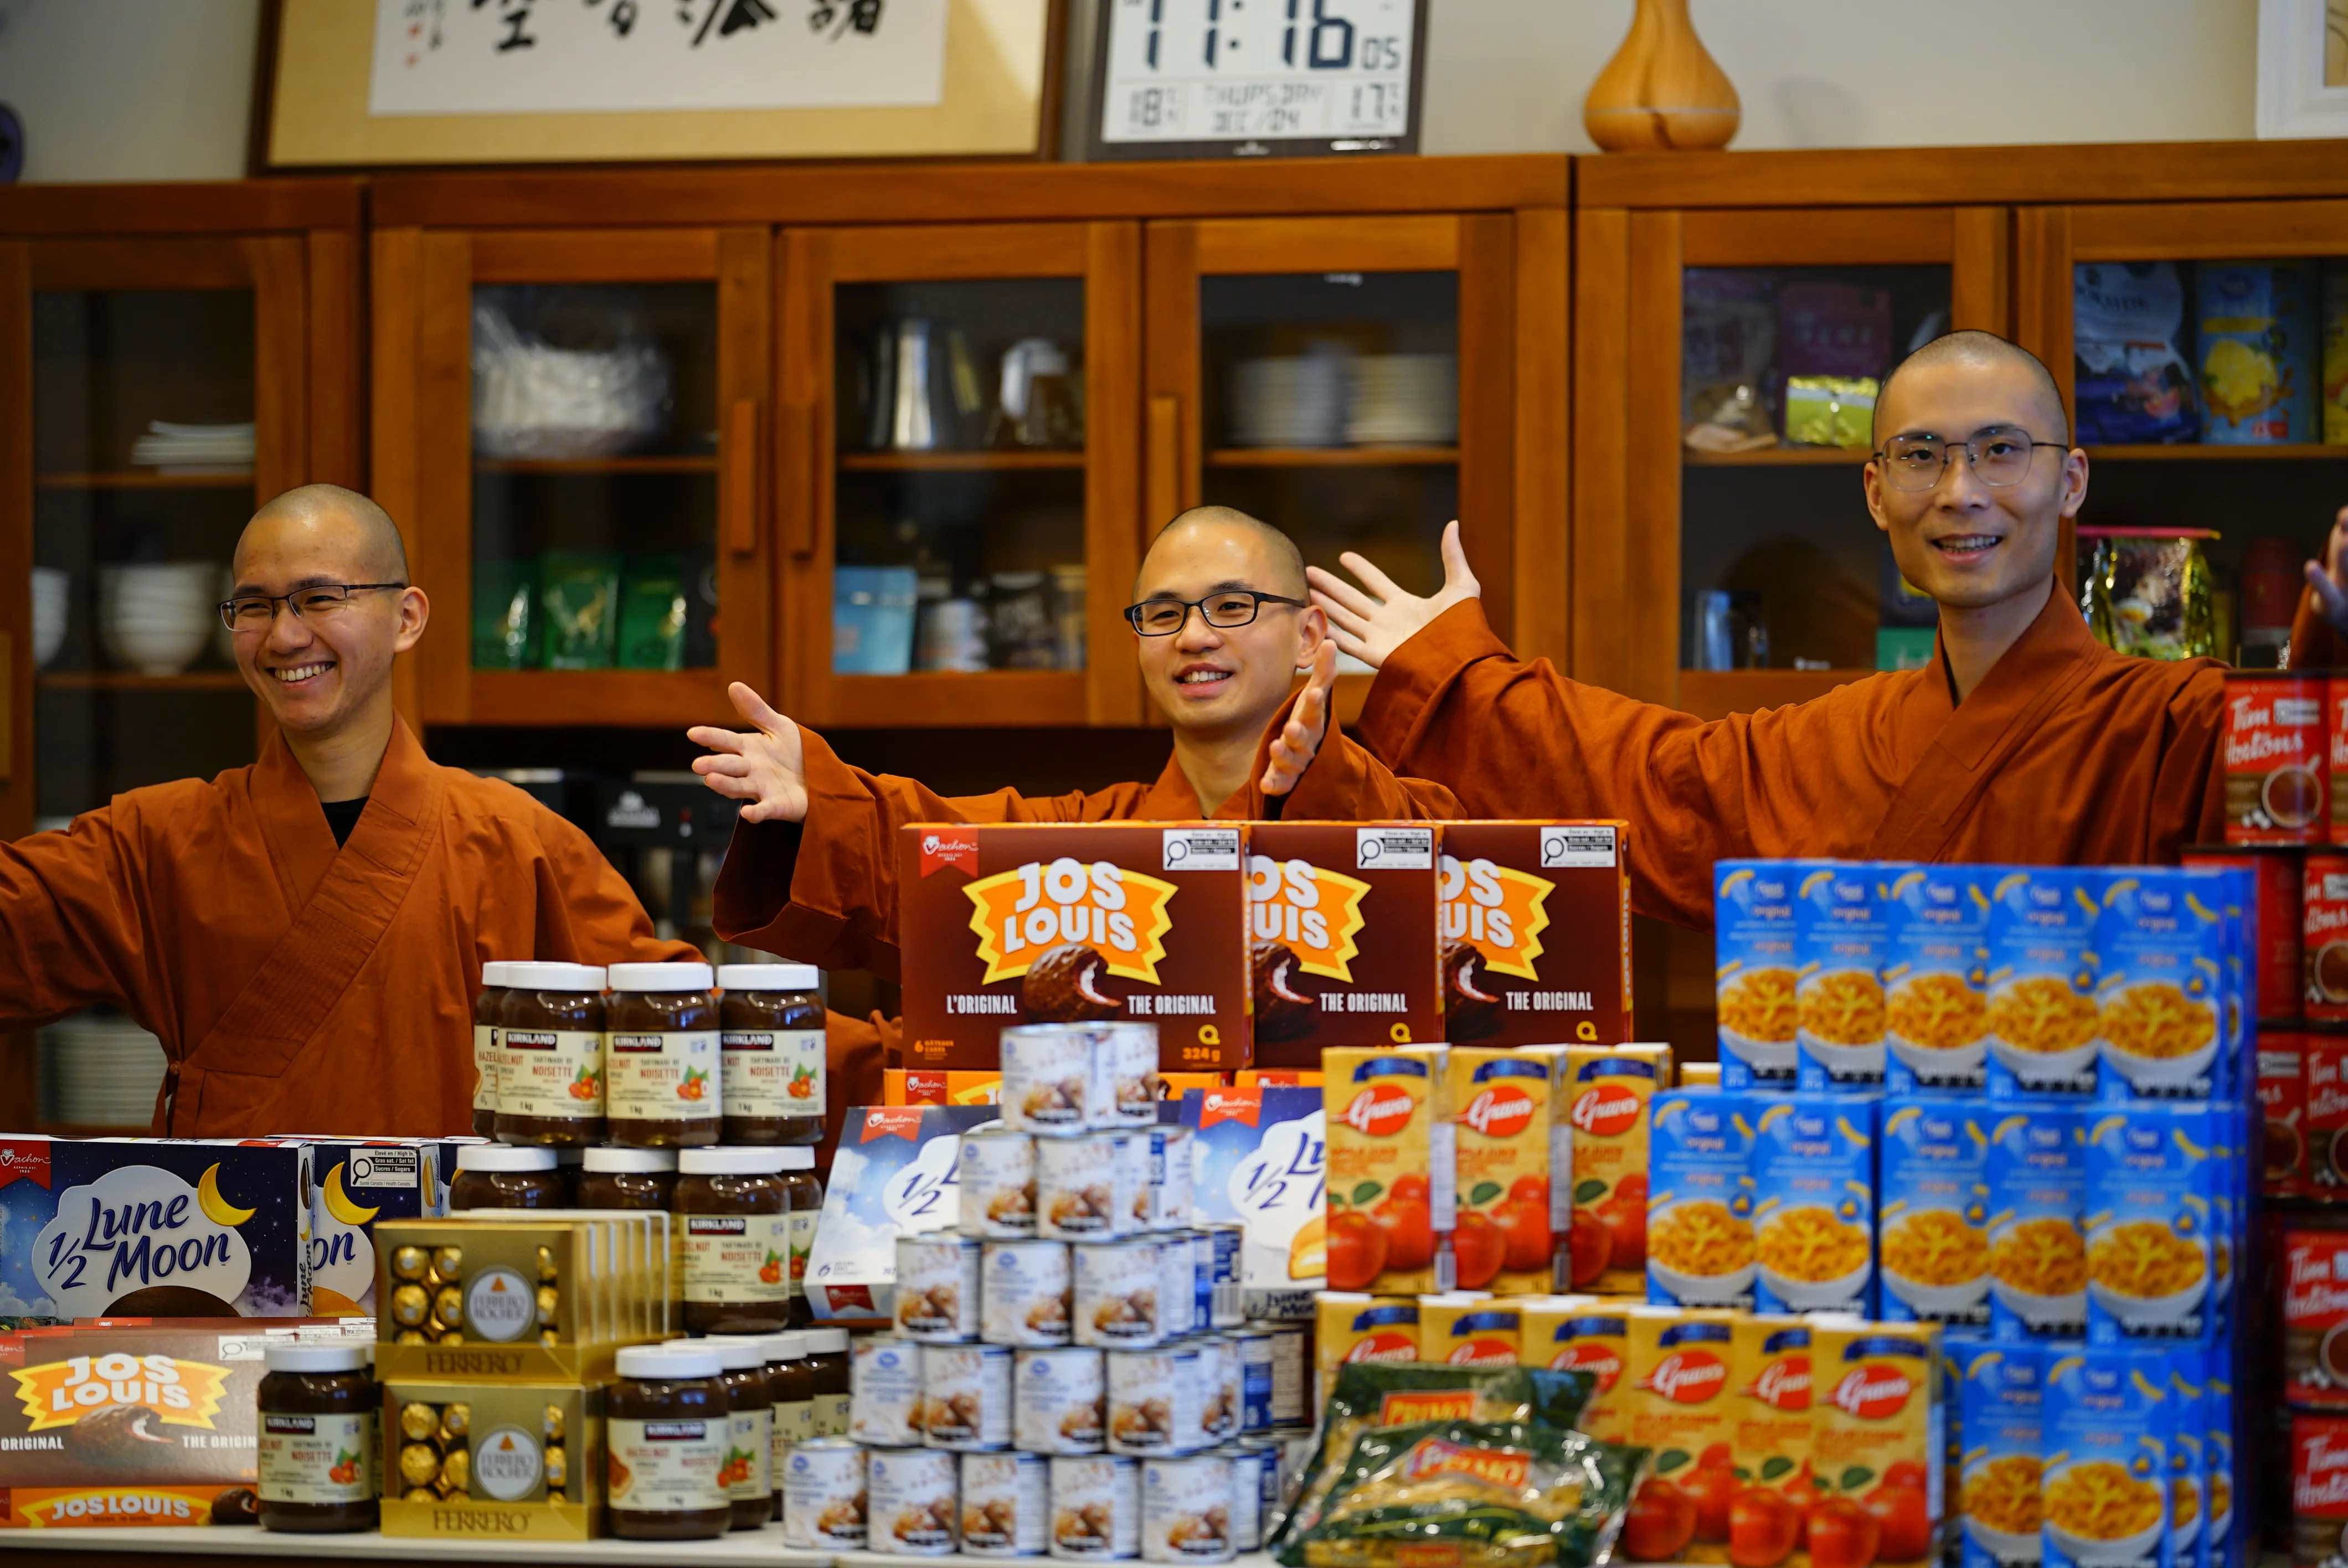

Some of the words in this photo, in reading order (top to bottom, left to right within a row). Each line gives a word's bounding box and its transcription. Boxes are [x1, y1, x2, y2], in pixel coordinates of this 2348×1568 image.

[1144, 0, 1355, 70] 11:16
[1360, 36, 1401, 70] 05
[1351, 83, 1384, 120] 17
[2230, 695, 2269, 732] Tim
[2225, 730, 2304, 766] Hortons
[1015, 857, 1126, 913] JOS
[1250, 855, 1320, 909] OS
[1441, 855, 1504, 907] OS
[1004, 904, 1137, 954] LOUIS
[1253, 903, 1330, 950] UIS
[1441, 903, 1515, 948] UIS
[946, 994, 1017, 1014] L'ORIGINAL
[1127, 995, 1153, 1014] THE
[1155, 995, 1216, 1014] ORIGINAL
[1320, 993, 1344, 1013] THE
[1347, 993, 1408, 1013] ORIGINAL
[1506, 991, 1530, 1010] THE
[1533, 991, 1594, 1010] ORIGINAL
[507, 1033, 556, 1045] KIRKLAND
[615, 1036, 662, 1047] KIRKLAND
[723, 1035, 773, 1045] KIRKLAND
[914, 1040, 924, 1053] 6
[1182, 1047, 1209, 1060] 324
[533, 1066, 573, 1077] NOISETTE
[640, 1069, 679, 1079] NOISETTE
[750, 1066, 790, 1077] NOISETTE
[1, 1153, 51, 1166] Vachon
[83, 1194, 190, 1251] Lune
[691, 1219, 745, 1230] KIRKLAND
[108, 1233, 231, 1293] Moon
[313, 1231, 356, 1270] on
[721, 1251, 762, 1262] NOISETTE
[299, 1263, 309, 1307] Lune
[64, 1354, 180, 1387] JOS
[426, 1352, 522, 1375] FERRERO
[52, 1381, 191, 1411] LOUIS
[1388, 1400, 1470, 1425] PRIMO
[1, 1437, 65, 1452] ORIGINAL
[183, 1436, 208, 1449] THE
[210, 1435, 257, 1449] ORIGIN
[1421, 1444, 1523, 1482] PRIMO
[52, 1497, 105, 1520] JOS
[108, 1495, 190, 1518] LOUIS
[433, 1509, 529, 1534] FERRERO
